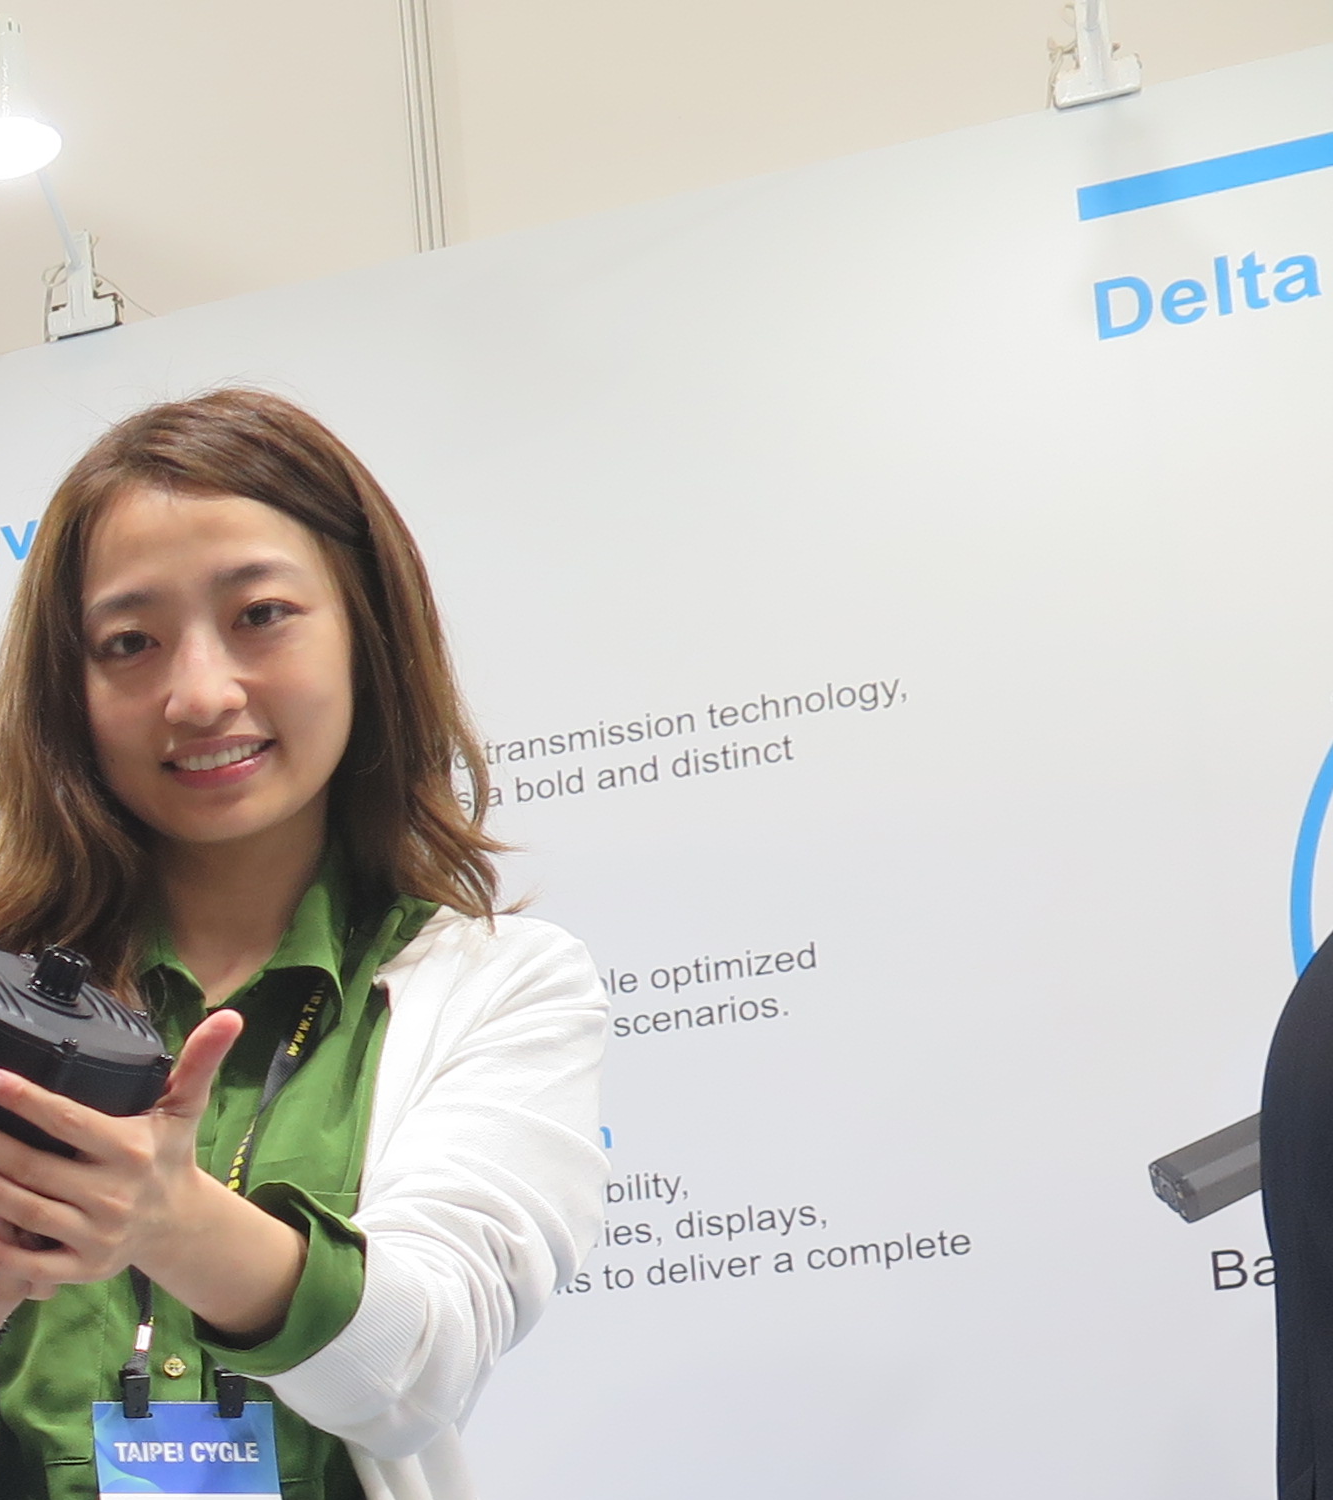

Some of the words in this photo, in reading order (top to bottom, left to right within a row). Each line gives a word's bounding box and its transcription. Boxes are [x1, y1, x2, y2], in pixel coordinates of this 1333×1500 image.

[1093, 250, 1323, 342] Delta
[485, 709, 696, 766] transmission
[707, 677, 908, 730] technology,
[515, 767, 585, 804] bold
[597, 755, 660, 791] and
[671, 734, 795, 778] distinct
[650, 942, 818, 994] optimized
[613, 994, 790, 1038] scenarios.
[675, 1199, 829, 1246] displays,
[602, 1264, 635, 1290] to
[646, 1247, 761, 1286] deliver
[773, 1250, 795, 1273] a
[806, 1228, 972, 1276] complete
[113, 1441, 184, 1463] TAIPEI
[190, 1441, 260, 1463] CYCLE
